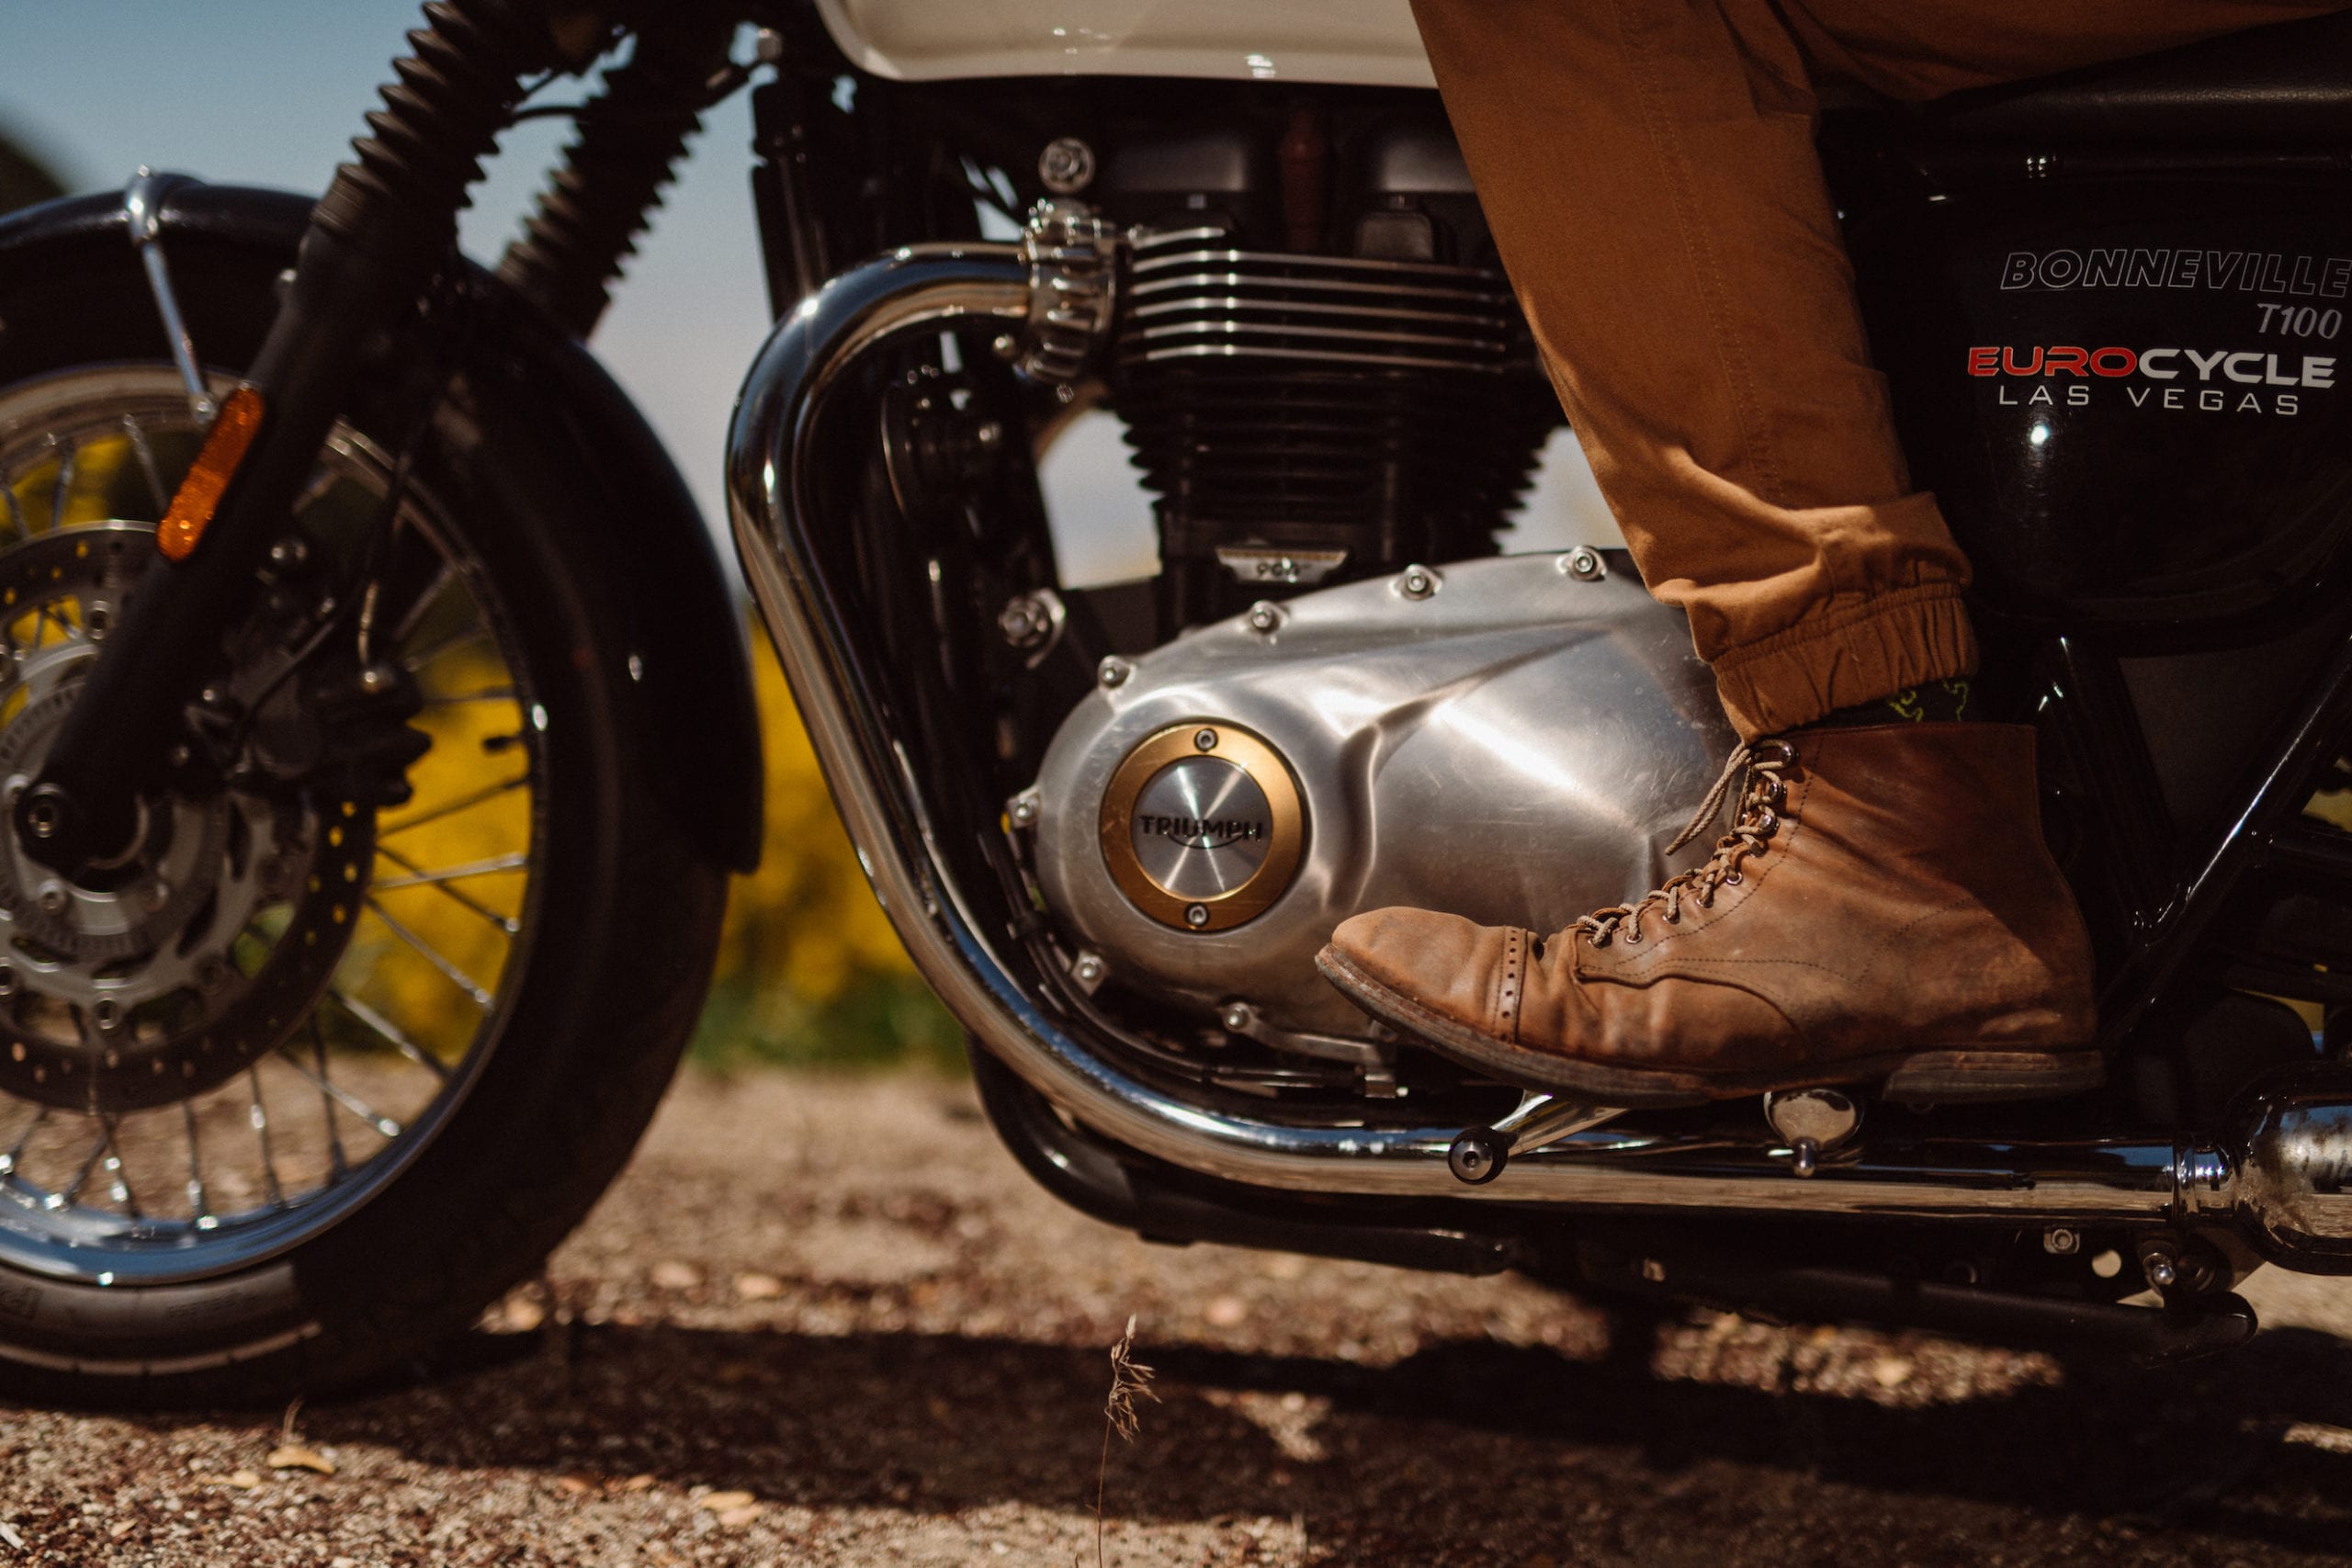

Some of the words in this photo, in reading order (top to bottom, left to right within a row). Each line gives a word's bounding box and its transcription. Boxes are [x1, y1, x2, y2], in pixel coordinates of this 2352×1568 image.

[2000, 249, 2352, 299] BONNEVILLE
[2257, 303, 2343, 340] T100
[1968, 346, 2337, 389] EUROCYCLE
[1999, 385, 2090, 406] LAS
[2126, 387, 2299, 416] VEGAS
[1140, 815, 1262, 841] TRIUMPH
